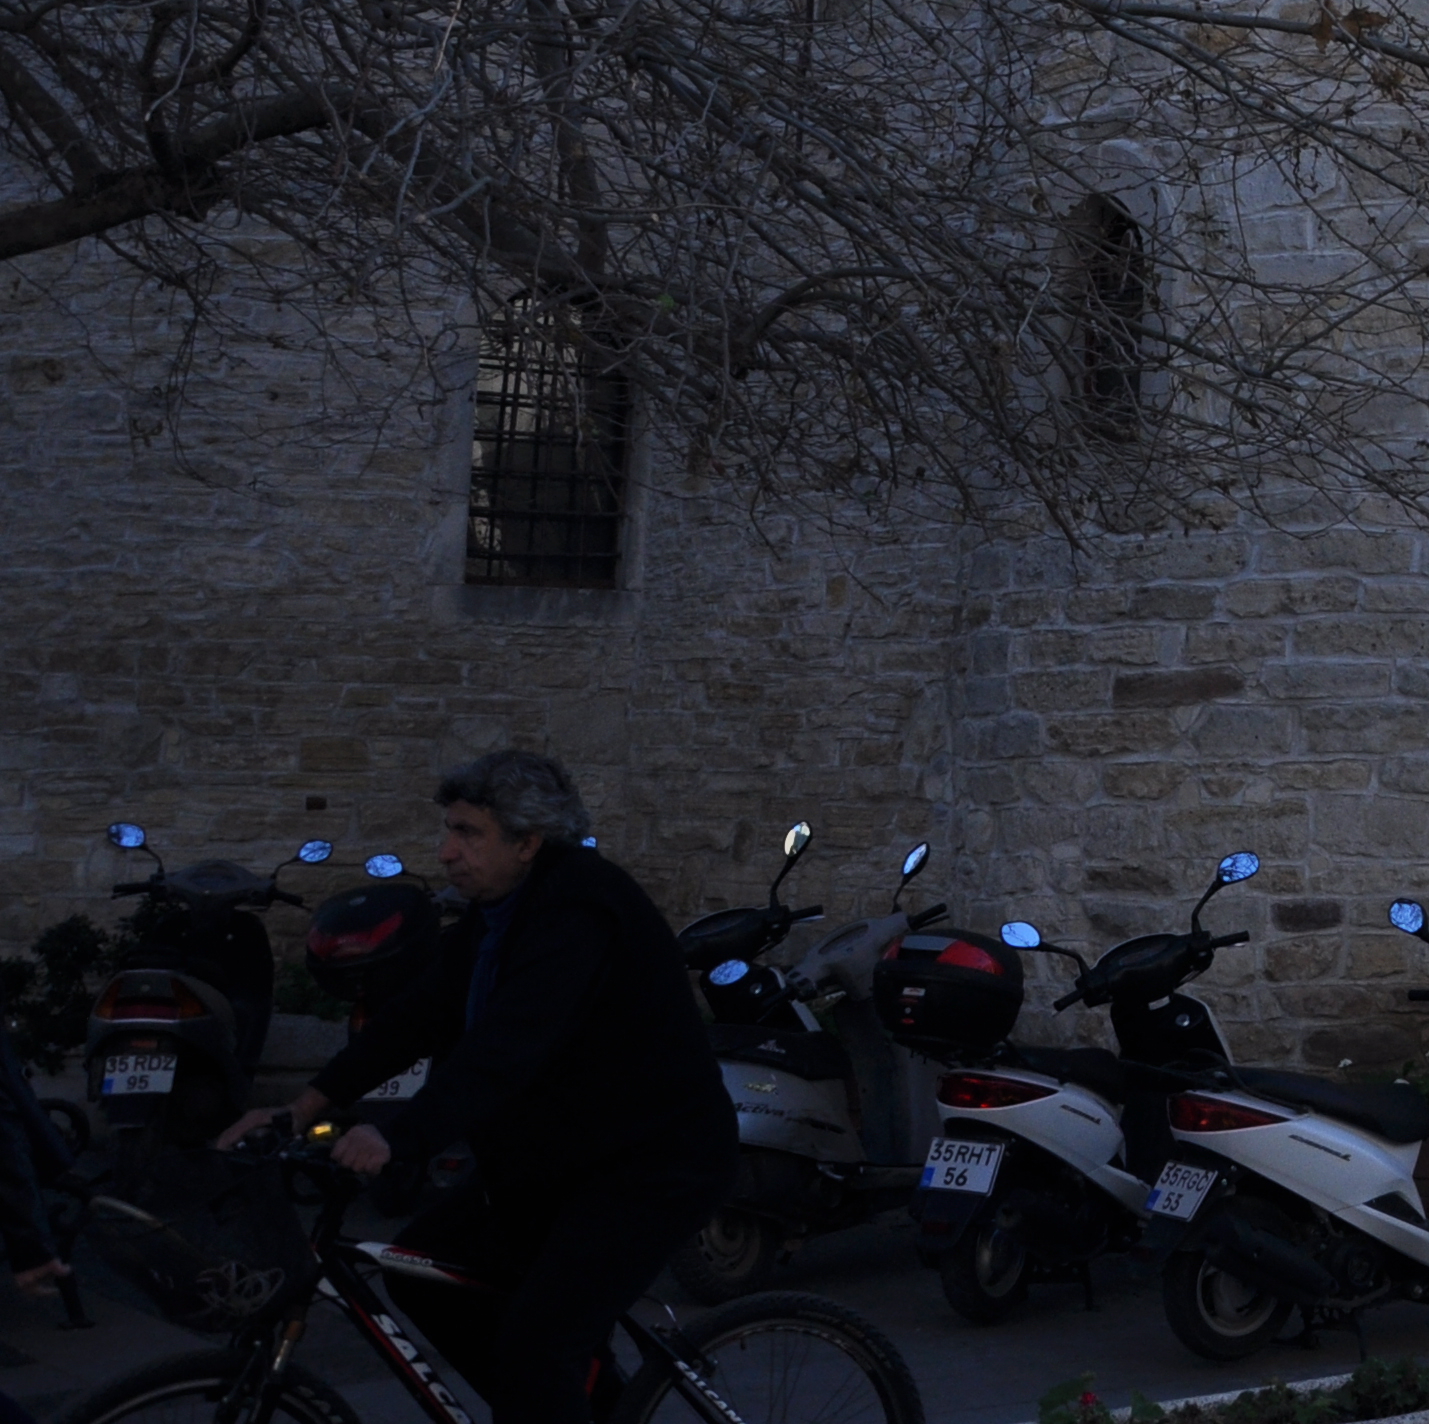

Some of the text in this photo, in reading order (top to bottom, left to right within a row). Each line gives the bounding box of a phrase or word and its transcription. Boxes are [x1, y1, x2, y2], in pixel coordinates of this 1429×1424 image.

[107, 1056, 129, 1073] 35
[127, 1076, 148, 1090] 95
[943, 1167, 968, 1187] 56
[1162, 1191, 1182, 1212] 53
